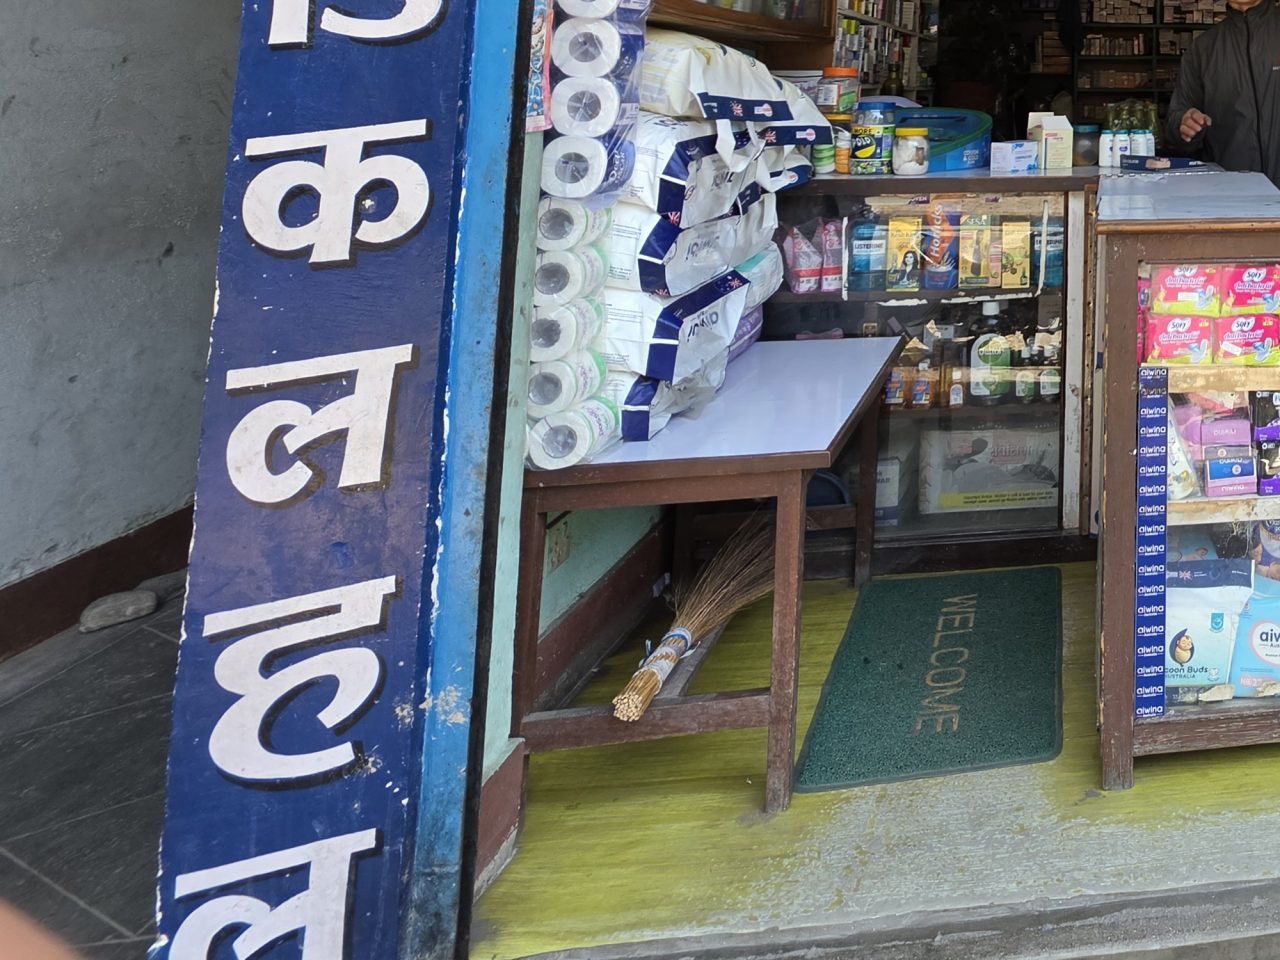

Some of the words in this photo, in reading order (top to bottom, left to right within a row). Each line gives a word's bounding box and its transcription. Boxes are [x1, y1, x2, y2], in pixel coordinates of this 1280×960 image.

[930, 203, 943, 257] Horlicks
[908, 593, 978, 740] WELCOME
[1165, 666, 1185, 674] coon
[1187, 665, 1209, 674] Buds
